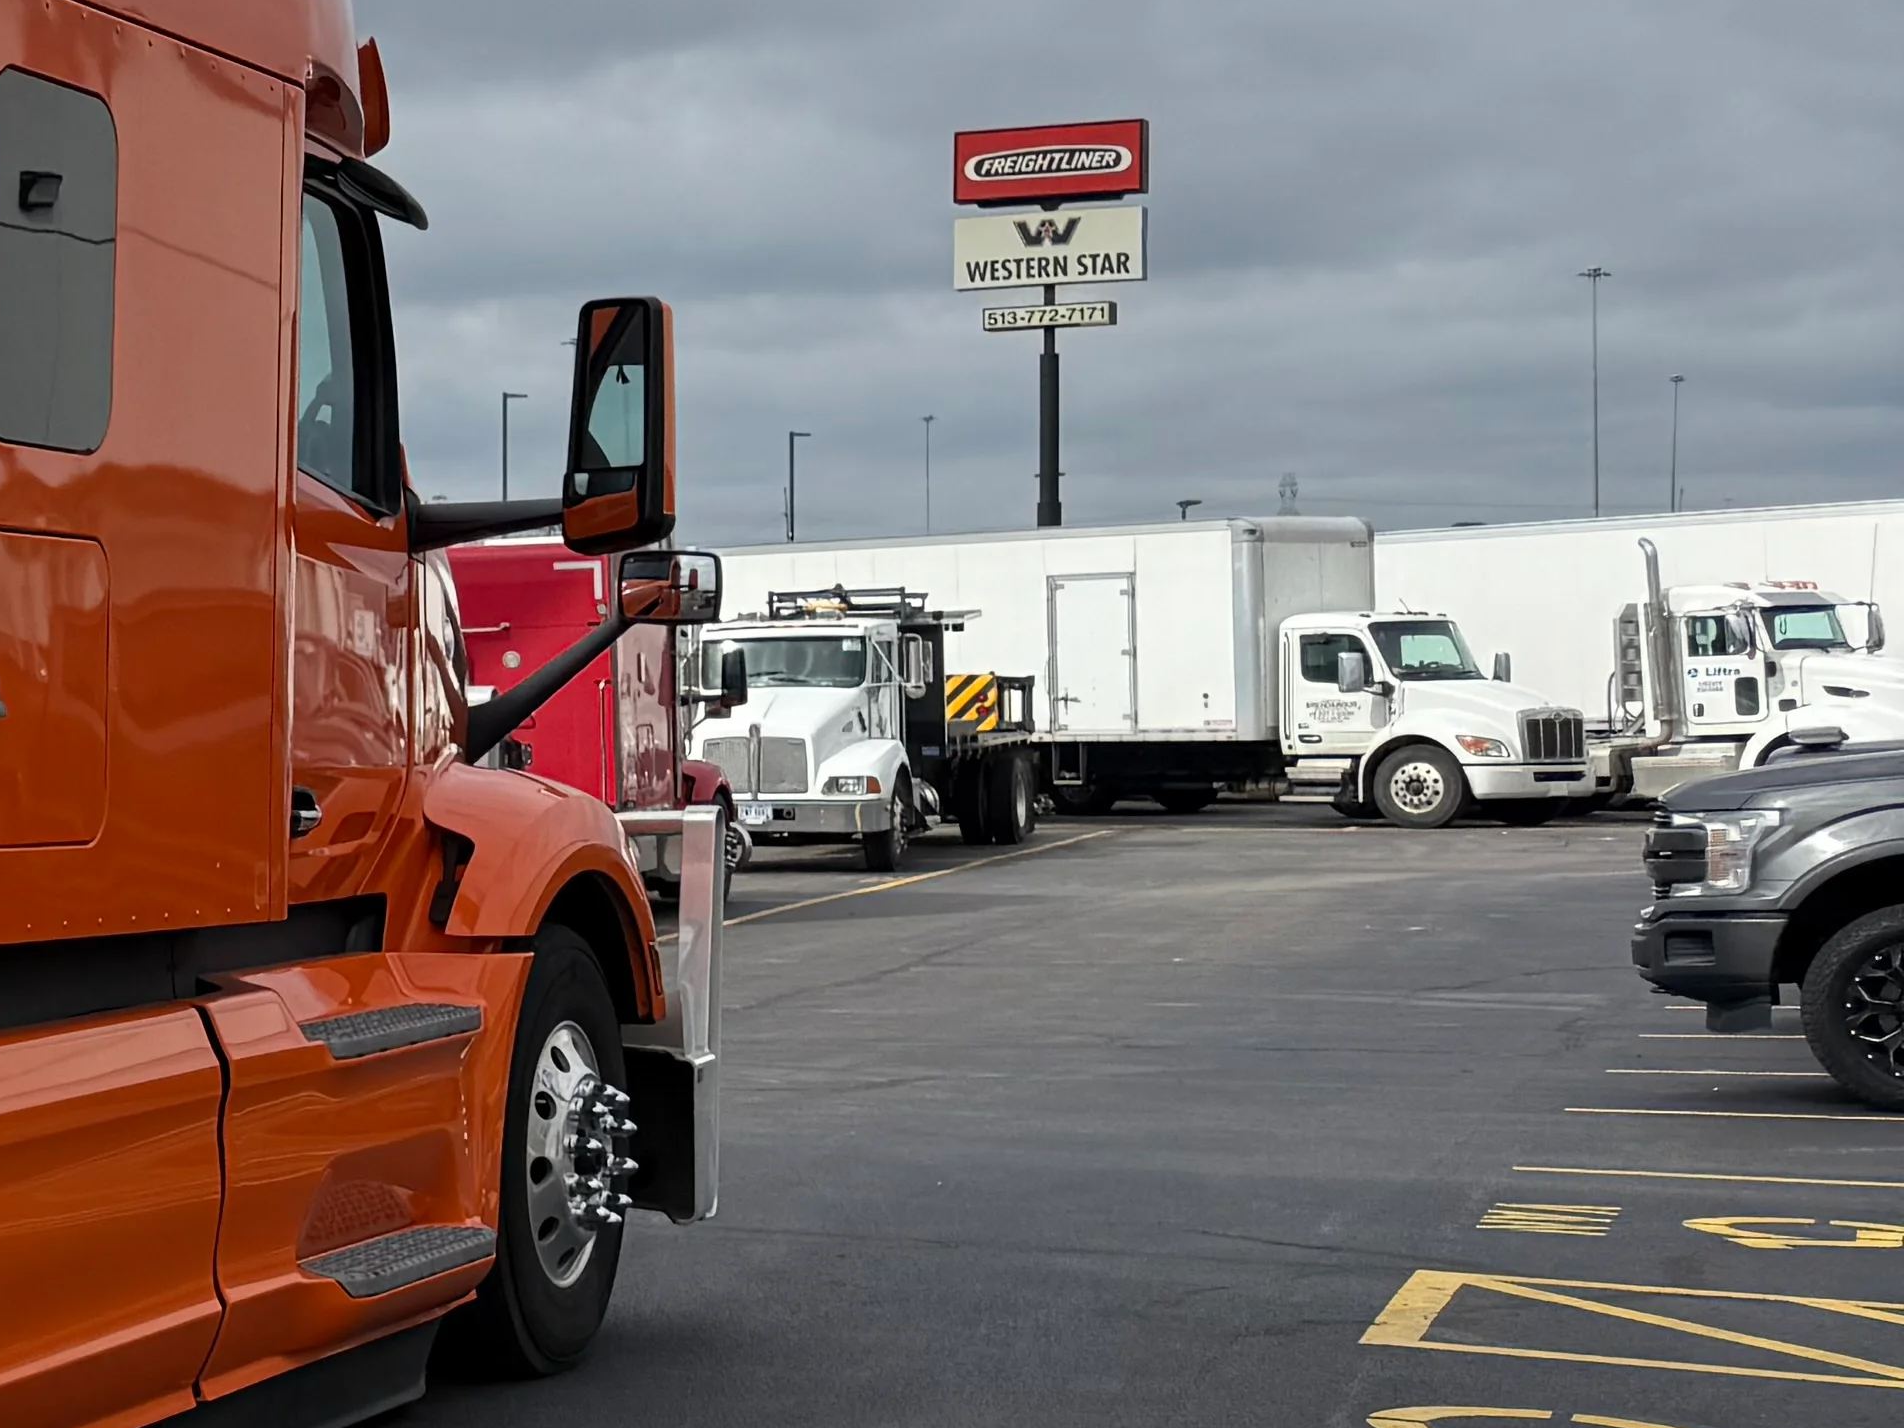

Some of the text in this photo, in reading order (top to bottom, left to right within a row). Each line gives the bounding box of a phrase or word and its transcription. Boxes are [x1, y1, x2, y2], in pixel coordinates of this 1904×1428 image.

[980, 151, 1117, 176] FREIGHTLINER
[966, 251, 1130, 283] WESTERN STAR
[987, 306, 1106, 327] 513-772-7171
